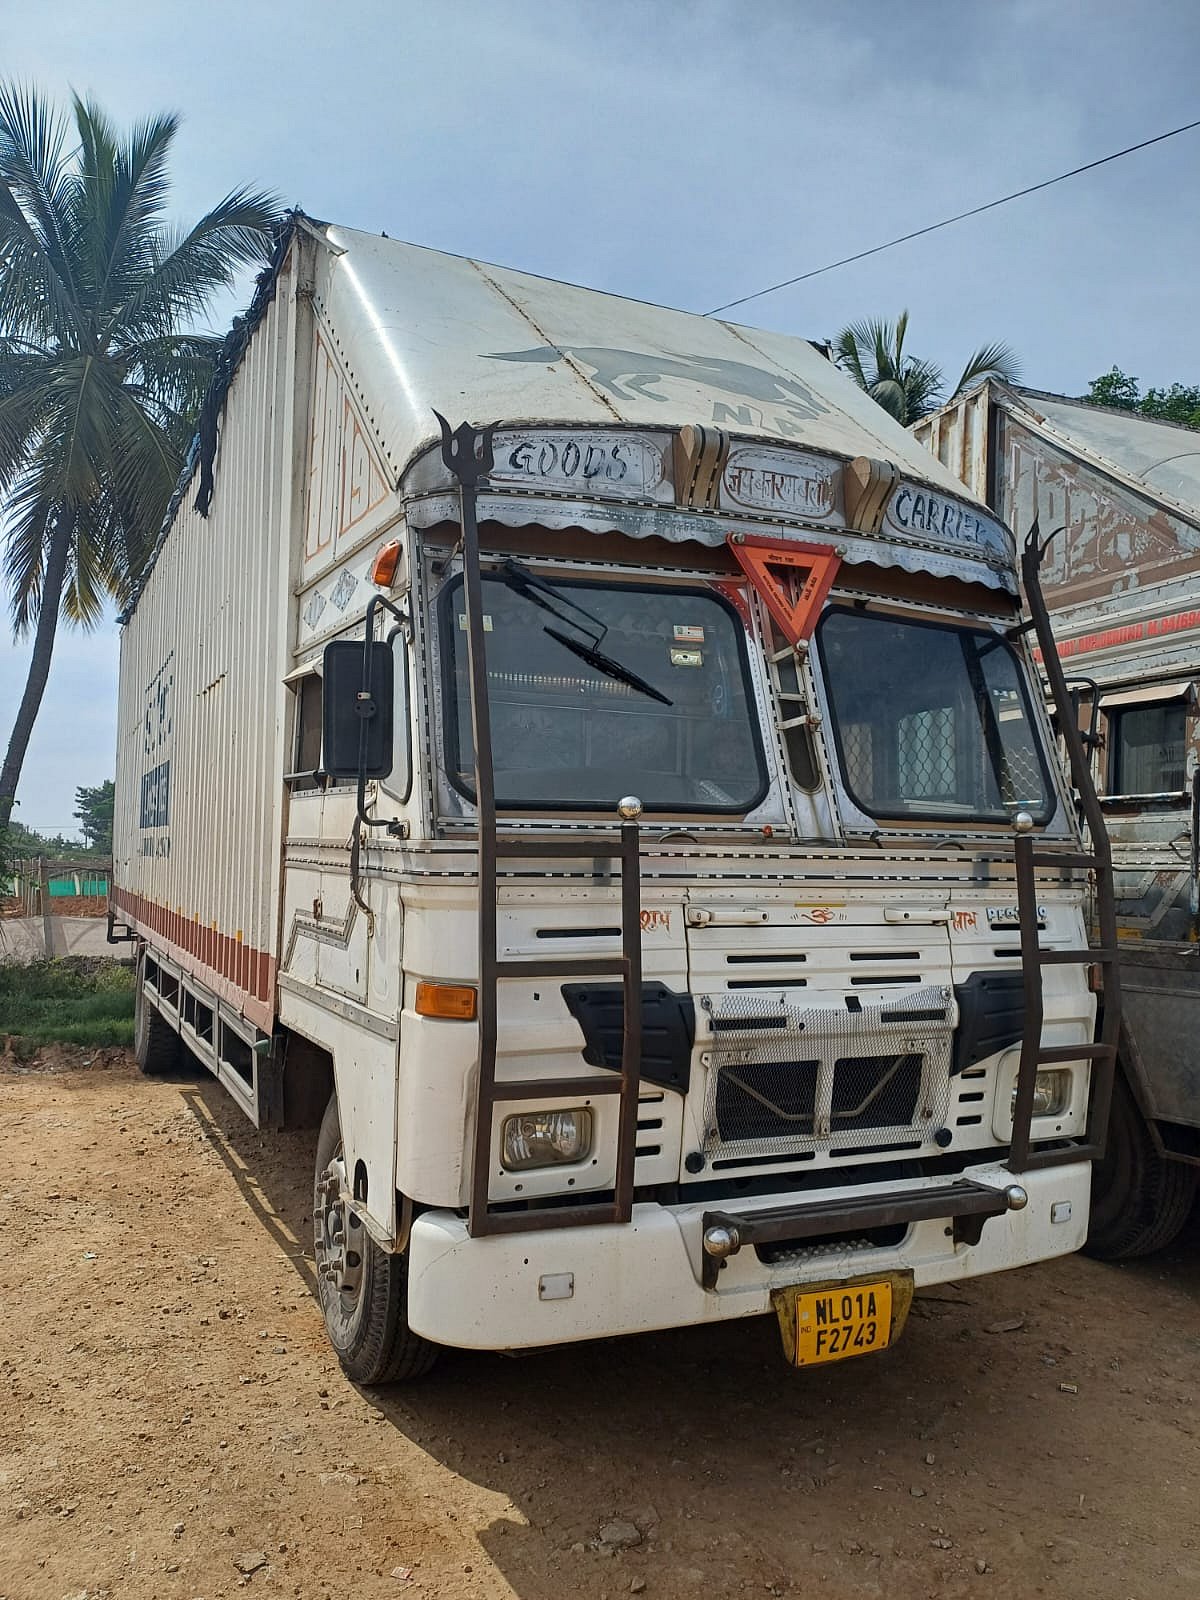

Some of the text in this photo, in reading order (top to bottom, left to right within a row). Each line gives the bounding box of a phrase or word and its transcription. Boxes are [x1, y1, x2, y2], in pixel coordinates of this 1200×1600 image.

[508, 441, 627, 481] GOODS
[815, 1291, 877, 1326] NL01A
[815, 1321, 877, 1356] F2743
